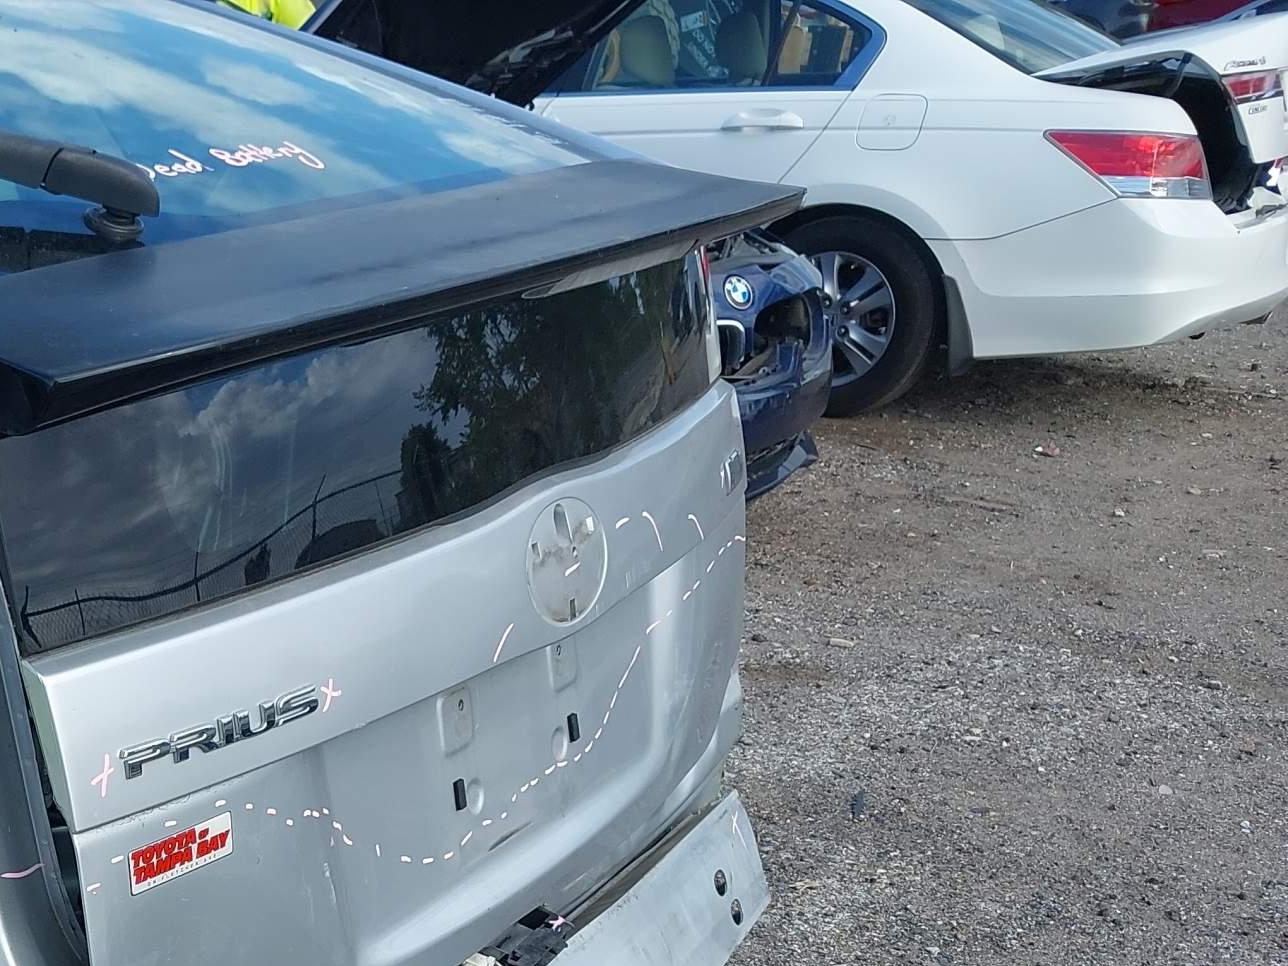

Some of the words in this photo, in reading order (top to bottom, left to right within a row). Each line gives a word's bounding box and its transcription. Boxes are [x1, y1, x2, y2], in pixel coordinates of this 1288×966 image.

[209, 141, 325, 170] Battery
[117, 682, 319, 780] PRIUS
[132, 828, 197, 868] TOYOTA
[134, 845, 193, 885] TAMPA
[196, 829, 230, 859] BAY
